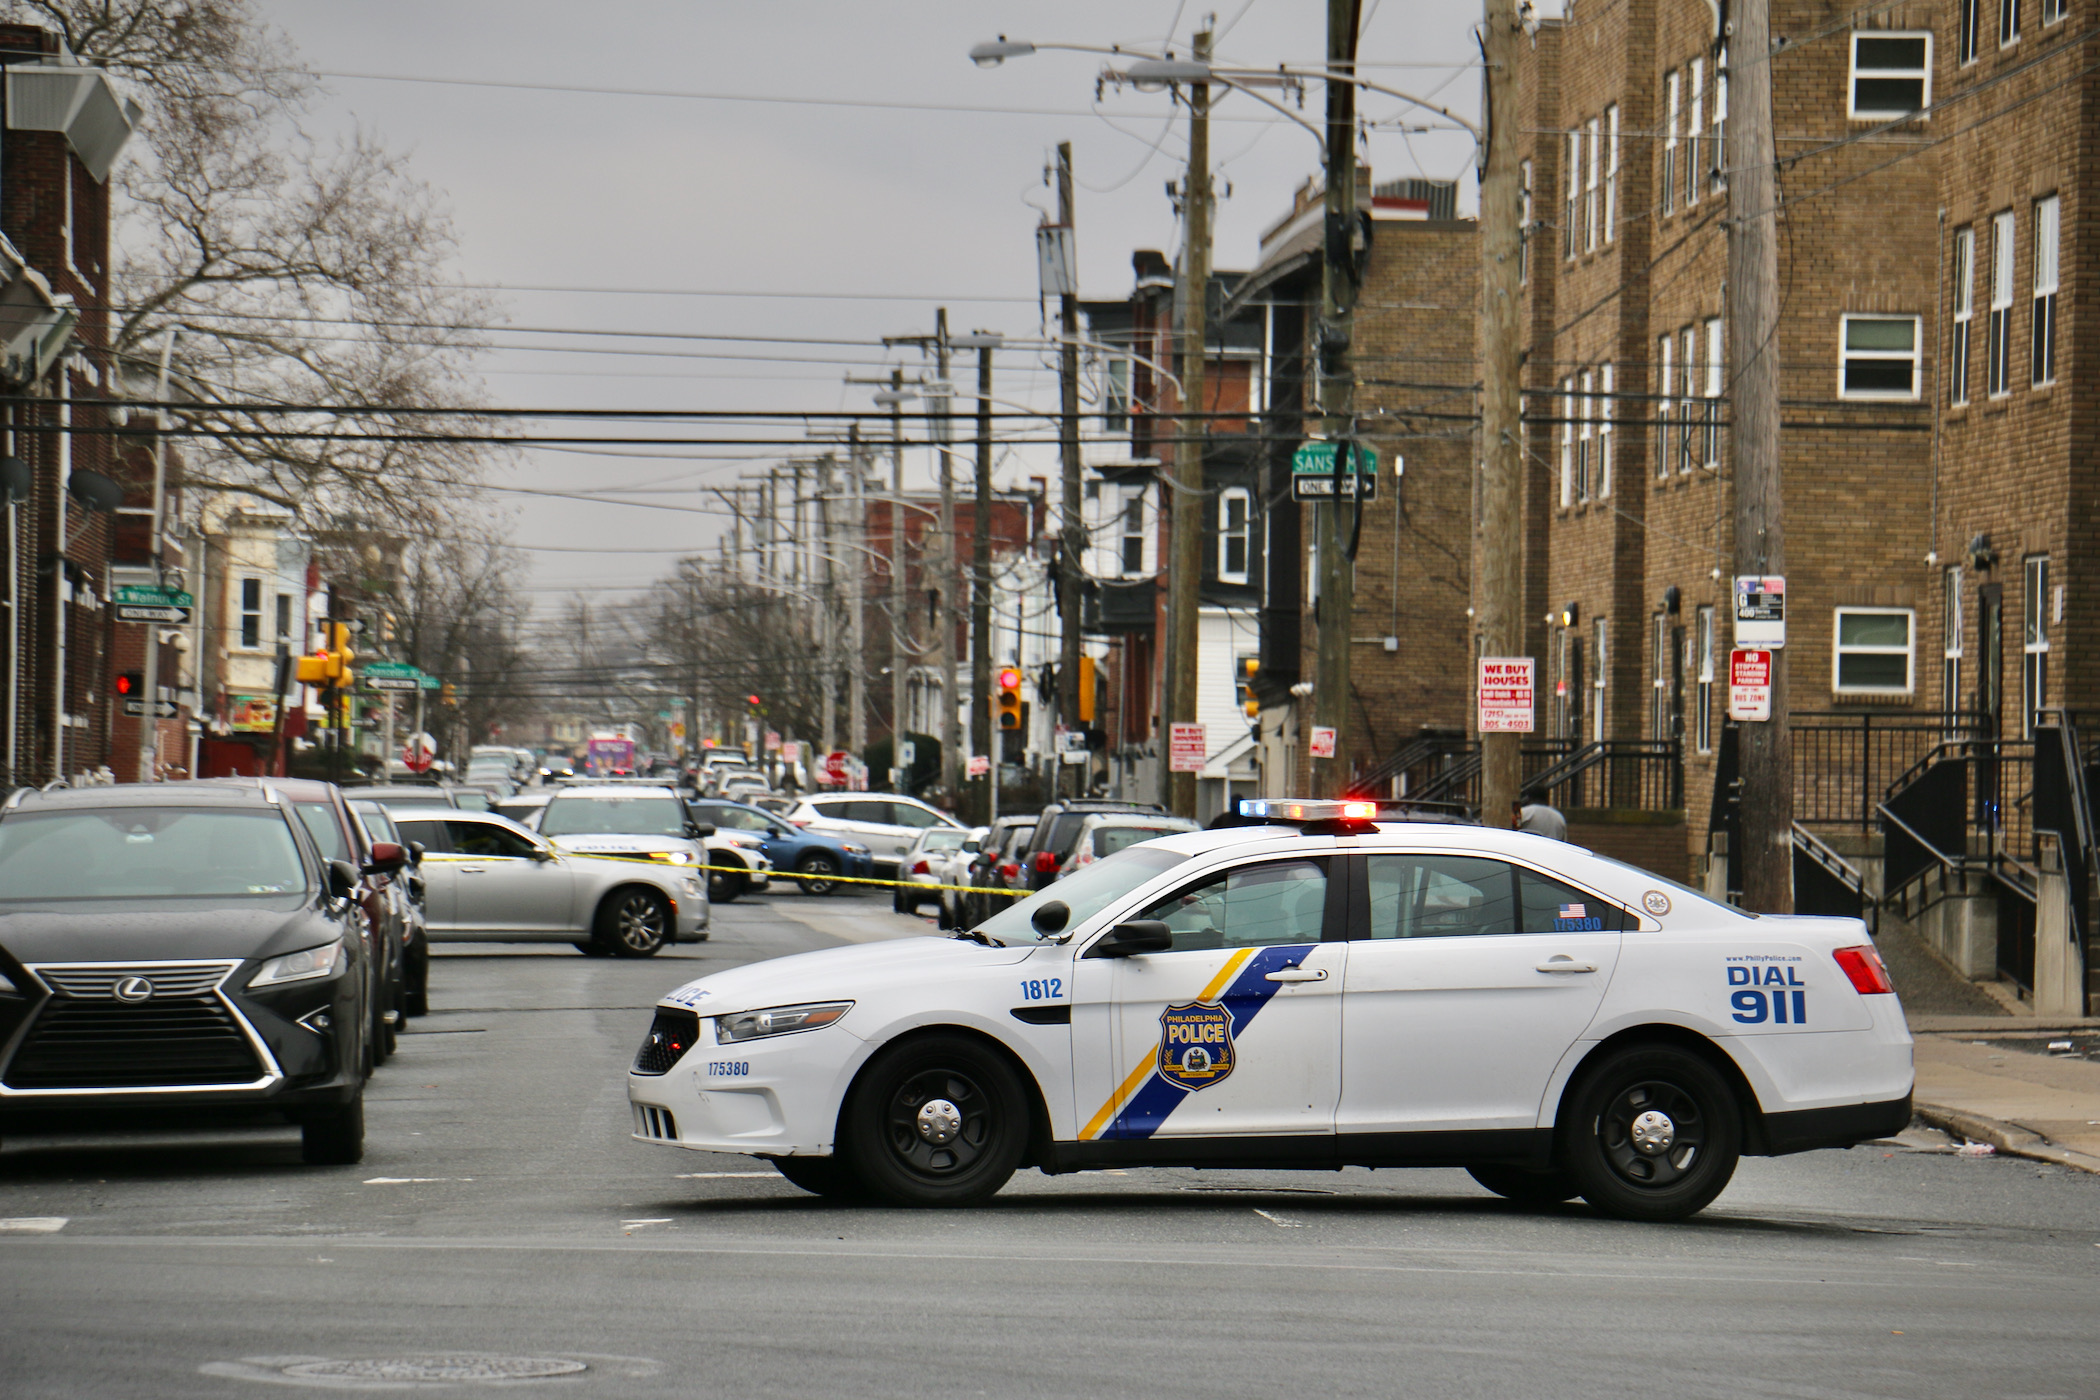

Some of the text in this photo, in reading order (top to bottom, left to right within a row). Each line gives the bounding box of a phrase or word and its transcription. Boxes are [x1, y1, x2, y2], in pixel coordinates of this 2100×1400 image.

[1295, 455, 1357, 472] SANSM
[1303, 482, 1324, 493] ONE
[1739, 593, 1748, 607] G
[126, 609, 169, 618] ONE WAY
[1739, 609, 1755, 618] 400
[1745, 652, 1759, 662] NO
[1484, 665, 1529, 674] WE BUY
[1484, 676, 1529, 685] HOUSES
[1735, 694, 1765, 702] BUS ZONE
[403, 751, 432, 764] SOP
[1553, 917, 1602, 931] 175380
[1727, 966, 1805, 986] DIAL
[1020, 978, 1063, 1000] 1812
[1731, 990, 1806, 1024] 911
[1167, 1015, 1224, 1023] PHILADELPHIA
[1168, 1024, 1225, 1044] POLICE
[708, 1061, 749, 1076] 175380
